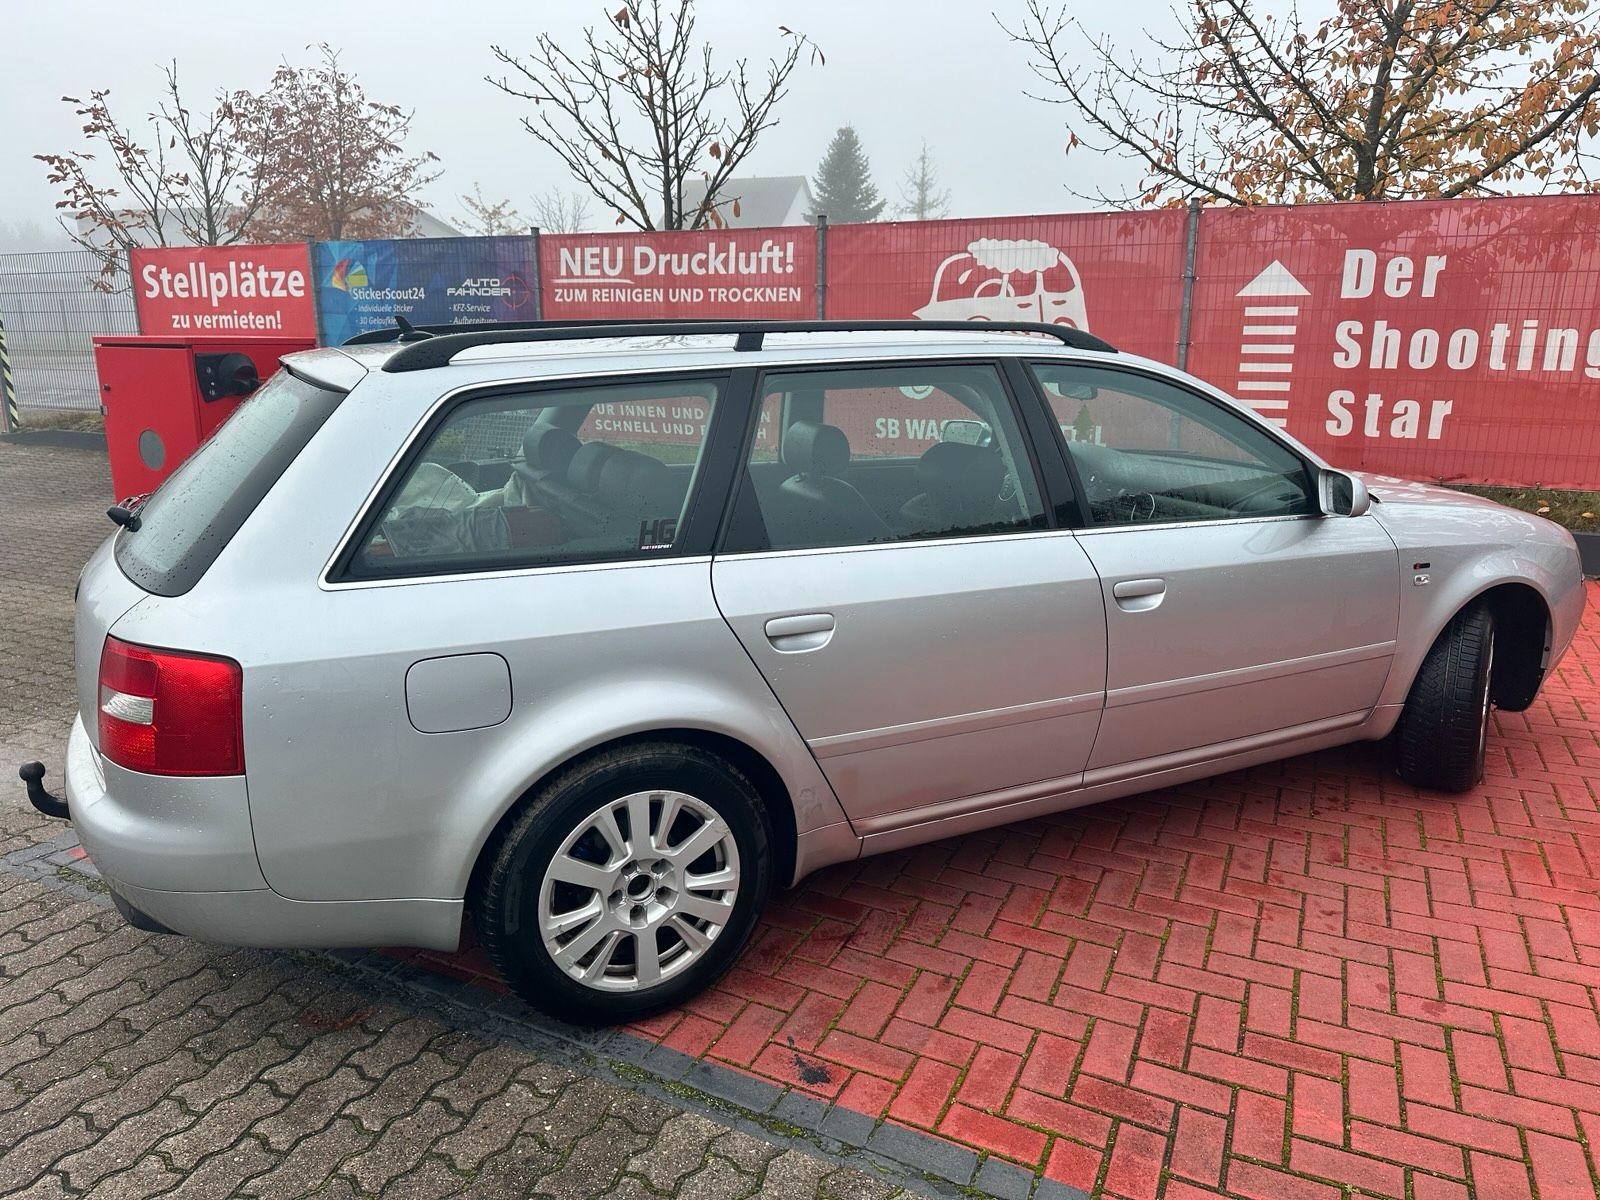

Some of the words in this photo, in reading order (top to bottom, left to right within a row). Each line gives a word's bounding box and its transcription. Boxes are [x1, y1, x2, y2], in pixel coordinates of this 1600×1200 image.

[559, 246, 624, 276] NEU
[634, 240, 795, 275] Druckluft!
[1340, 249, 1447, 298] Der
[142, 261, 305, 307] Stellplätze
[462, 278, 500, 287] AUTO
[352, 287, 425, 300] StickerScout24
[447, 287, 511, 296] FAHNDER
[554, 288, 587, 303] ZUM
[592, 288, 663, 303] REINIGEN
[669, 288, 704, 302] UND
[708, 287, 801, 302] TROCKNEN
[393, 304, 414, 312] Sticker
[453, 304, 491, 312] KFZ-Service
[172, 313, 190, 328] zu
[194, 310, 282, 329] vermieten!
[620, 404, 666, 418] INNEN
[671, 407, 704, 420] UND
[1325, 390, 1453, 440] Star
[595, 419, 658, 434] SCHNELL
[662, 423, 694, 436] UND
[875, 417, 899, 439] SB
